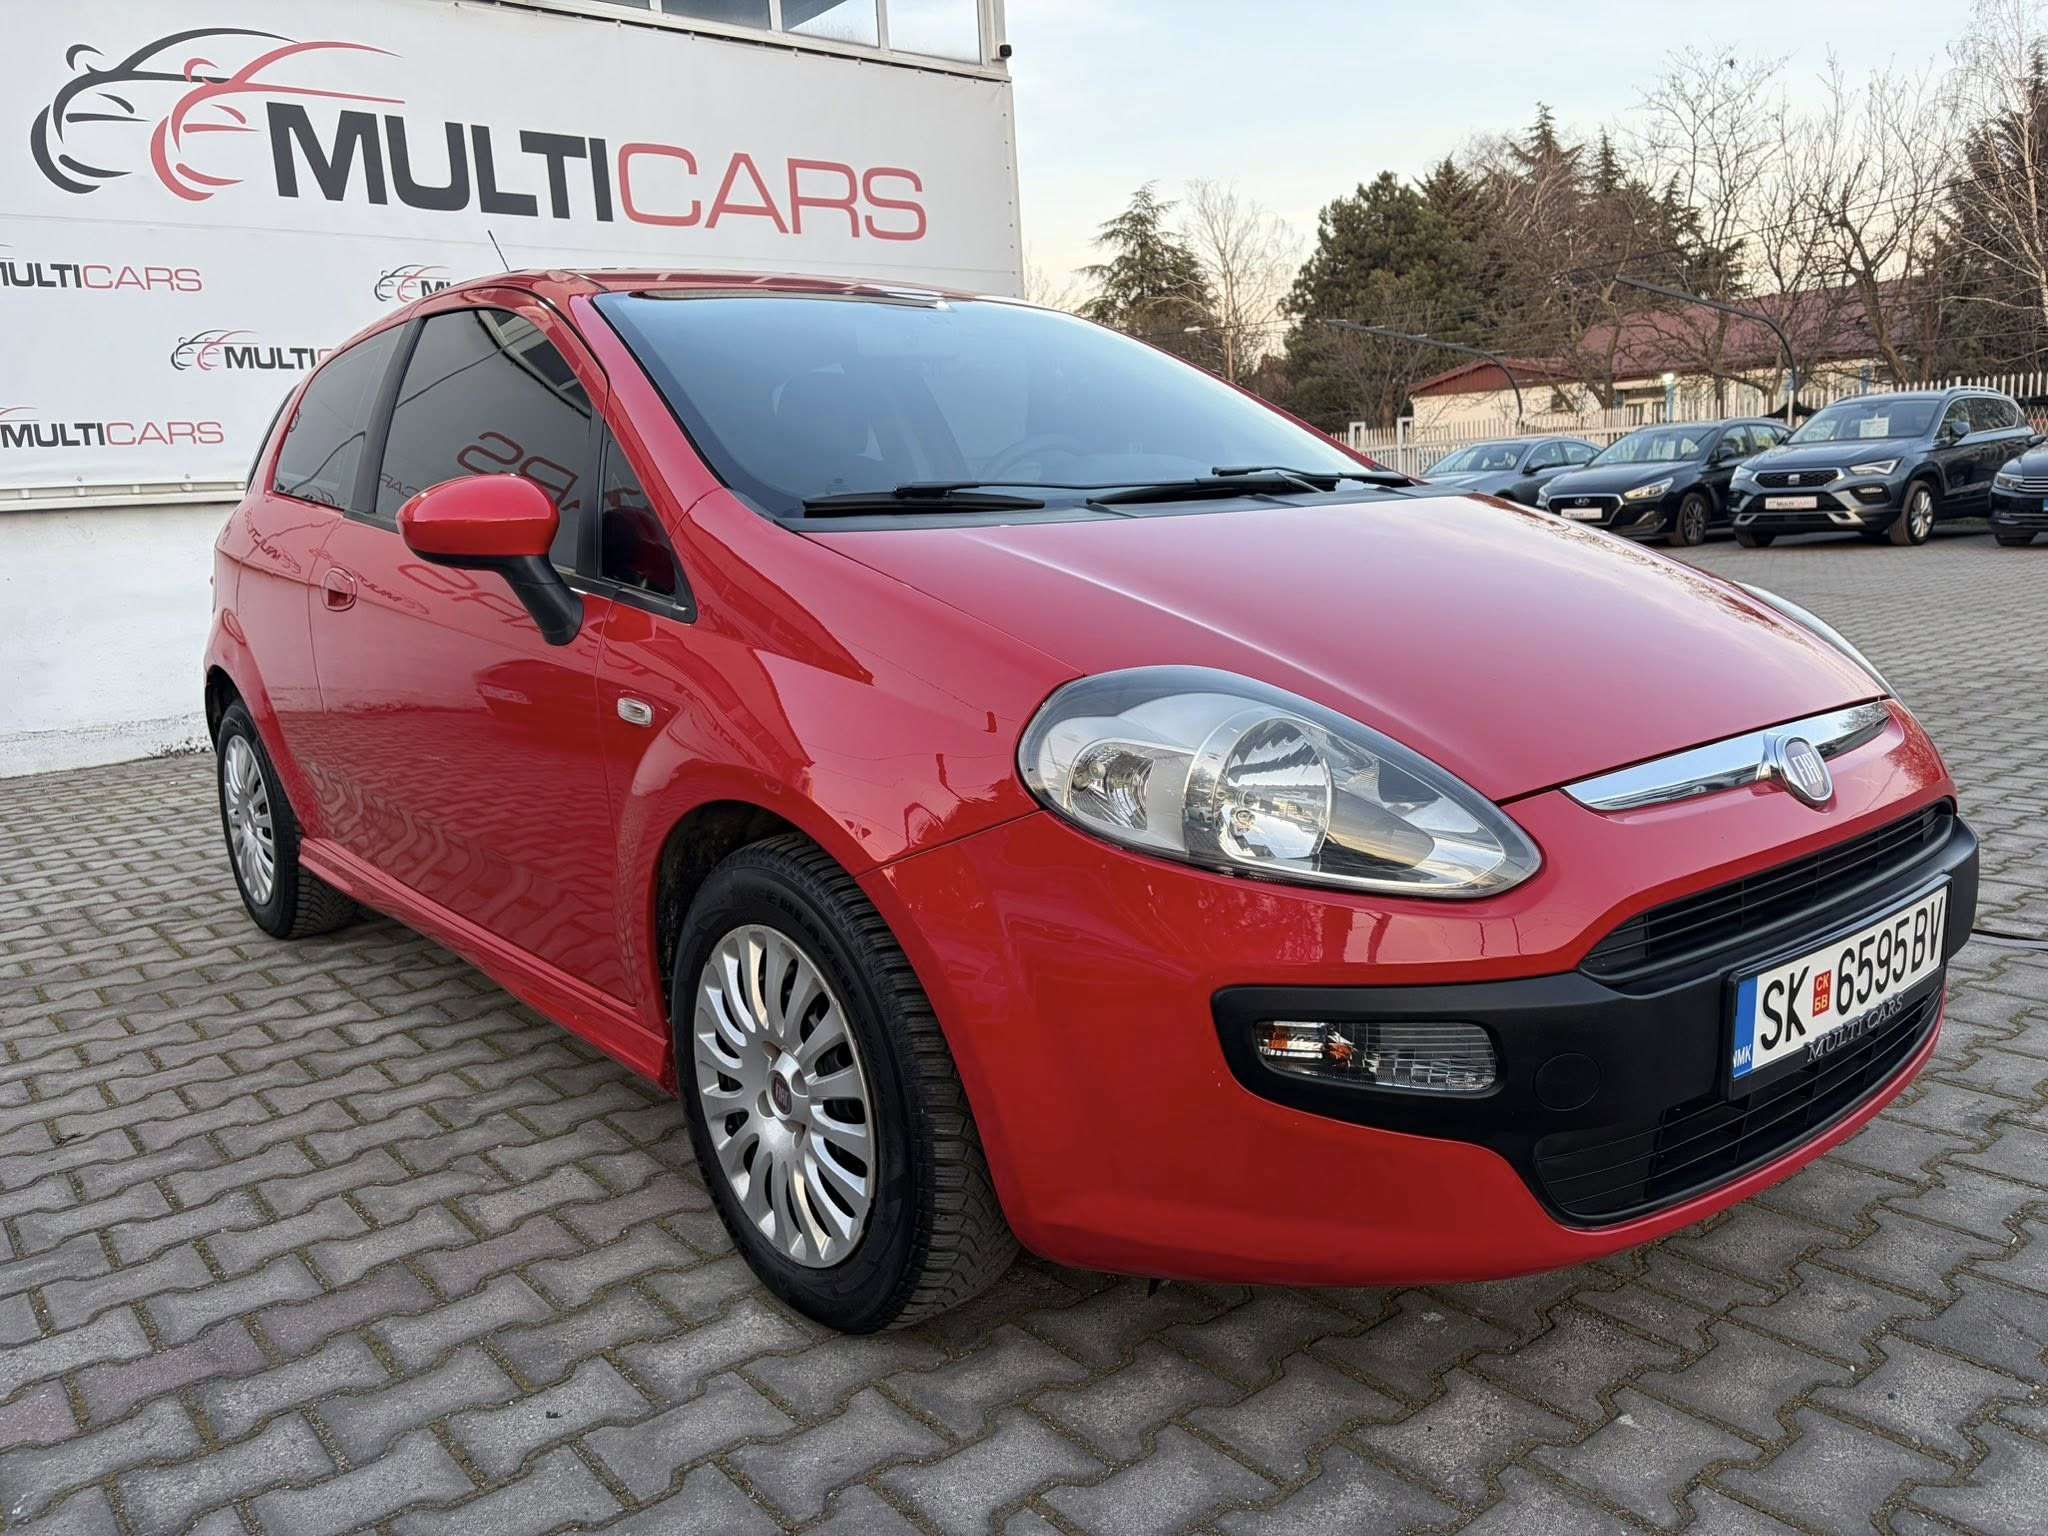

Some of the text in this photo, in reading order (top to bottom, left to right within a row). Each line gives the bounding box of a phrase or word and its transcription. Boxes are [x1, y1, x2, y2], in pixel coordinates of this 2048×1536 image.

[266, 102, 927, 241] MULTICARS
[0, 421, 225, 448] MULTICARS
[1760, 966, 1810, 1050] SK
[1806, 992, 1904, 1063] MULTI CARS
